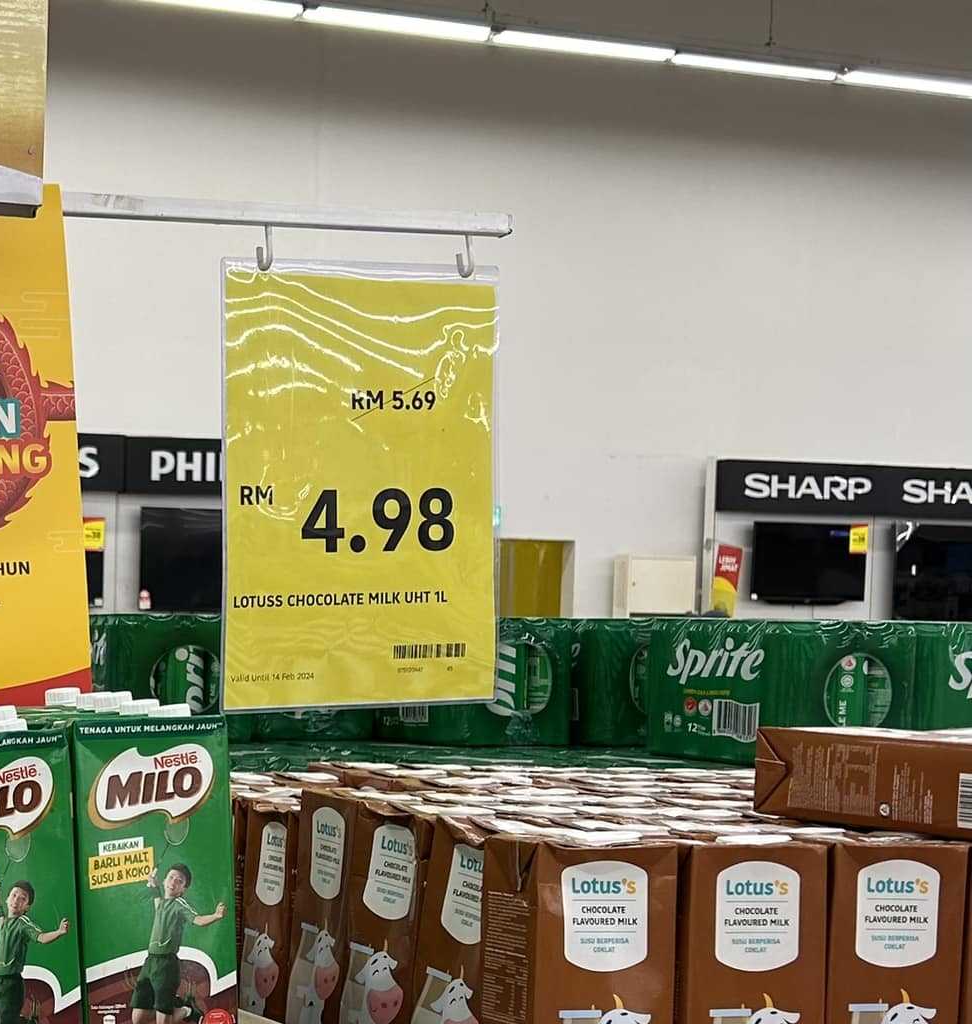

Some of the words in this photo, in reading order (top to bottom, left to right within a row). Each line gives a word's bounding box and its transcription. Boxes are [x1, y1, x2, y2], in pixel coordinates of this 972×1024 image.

[351, 390, 384, 411] RM
[392, 389, 436, 411] 5.69
[149, 450, 222, 482] PHI
[743, 472, 873, 501] SHARP
[902, 478, 972, 504] SHA
[239, 485, 274, 506] RM
[300, 487, 455, 554] 4.98
[233, 595, 283, 609] LOTUSS
[287, 592, 365, 608] CHOCOLATE
[369, 592, 401, 605] MILK
[404, 591, 431, 604] UHT
[434, 590, 448, 604] 1L
[667, 637, 765, 685] Sprite
[230, 673, 250, 683] Valid
[251, 672, 270, 682] Until
[272, 673, 281, 682] 14
[282, 672, 295, 682] Feb
[297, 672, 315, 682] 2024
[105, 766, 203, 812] MILO
[571, 877, 636, 894] Lotus's
[725, 879, 789, 896] Lotus's
[866, 877, 929, 895] Lotus's
[581, 905, 626, 914] CHOCOLATE
[874, 904, 918, 913] CHOCOLATE
[572, 917, 616, 926] FLAVOURED
[617, 917, 638, 926] MILK
[864, 915, 908, 924] FLAVOURED
[909, 916, 929, 924] MILK
